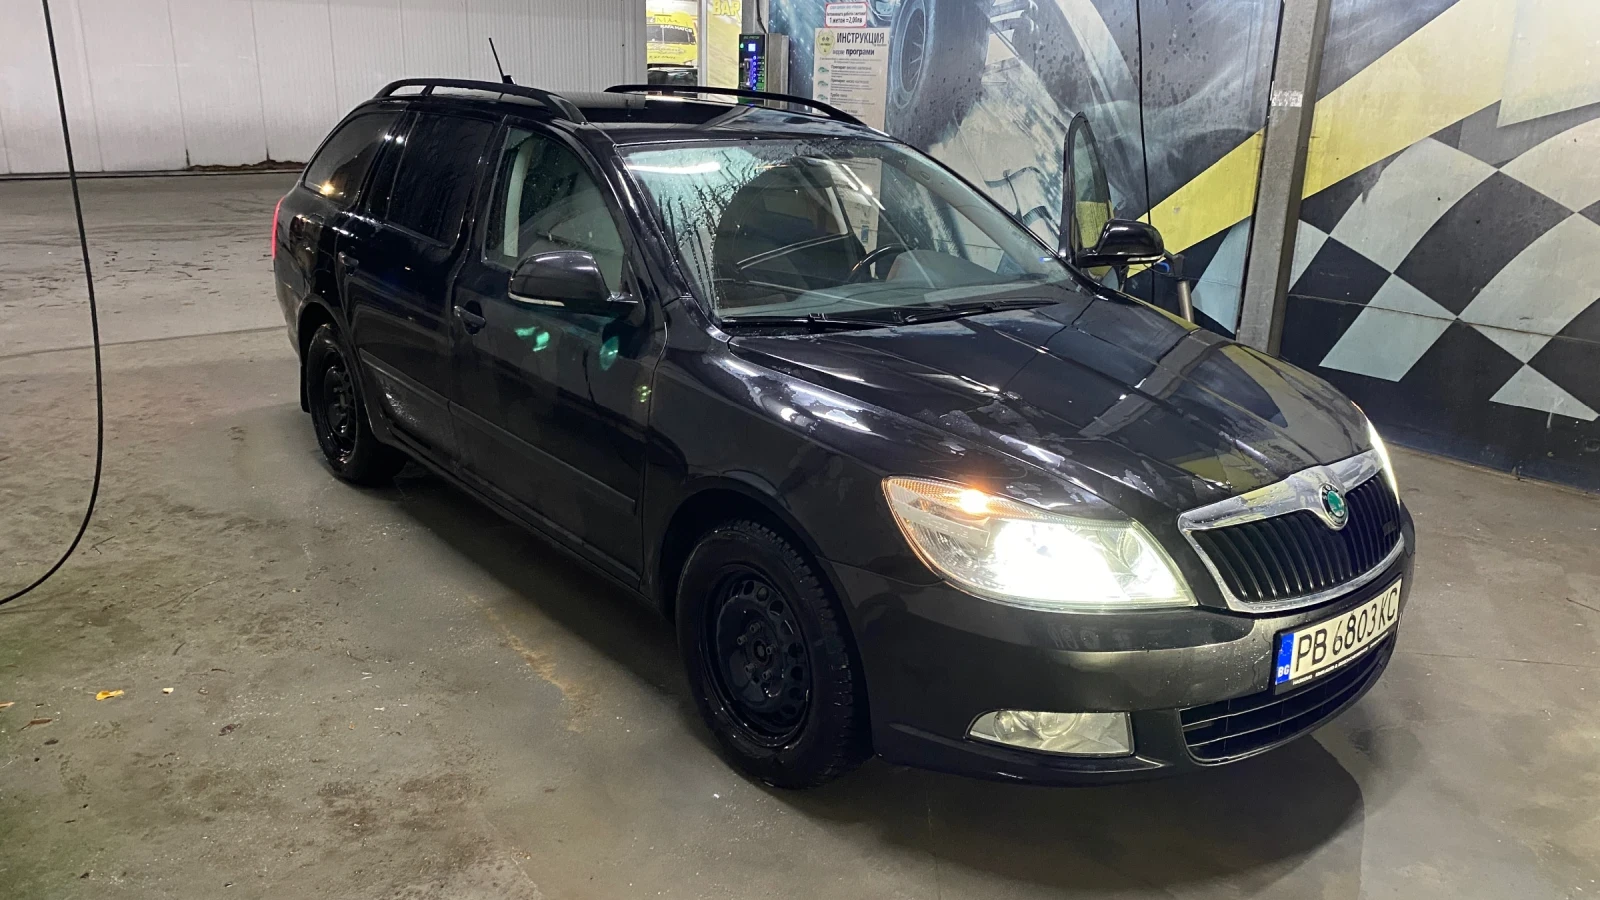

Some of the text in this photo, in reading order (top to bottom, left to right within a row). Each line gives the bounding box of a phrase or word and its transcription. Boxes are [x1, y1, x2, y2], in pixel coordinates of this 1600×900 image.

[836, 32, 885, 44] ИНСТРУКЦИЯ
[846, 48, 875, 57] програми
[1295, 628, 1328, 673] PB
[1332, 603, 1378, 656] 6803
[1377, 587, 1398, 631] KC
[1277, 664, 1291, 678] BG
